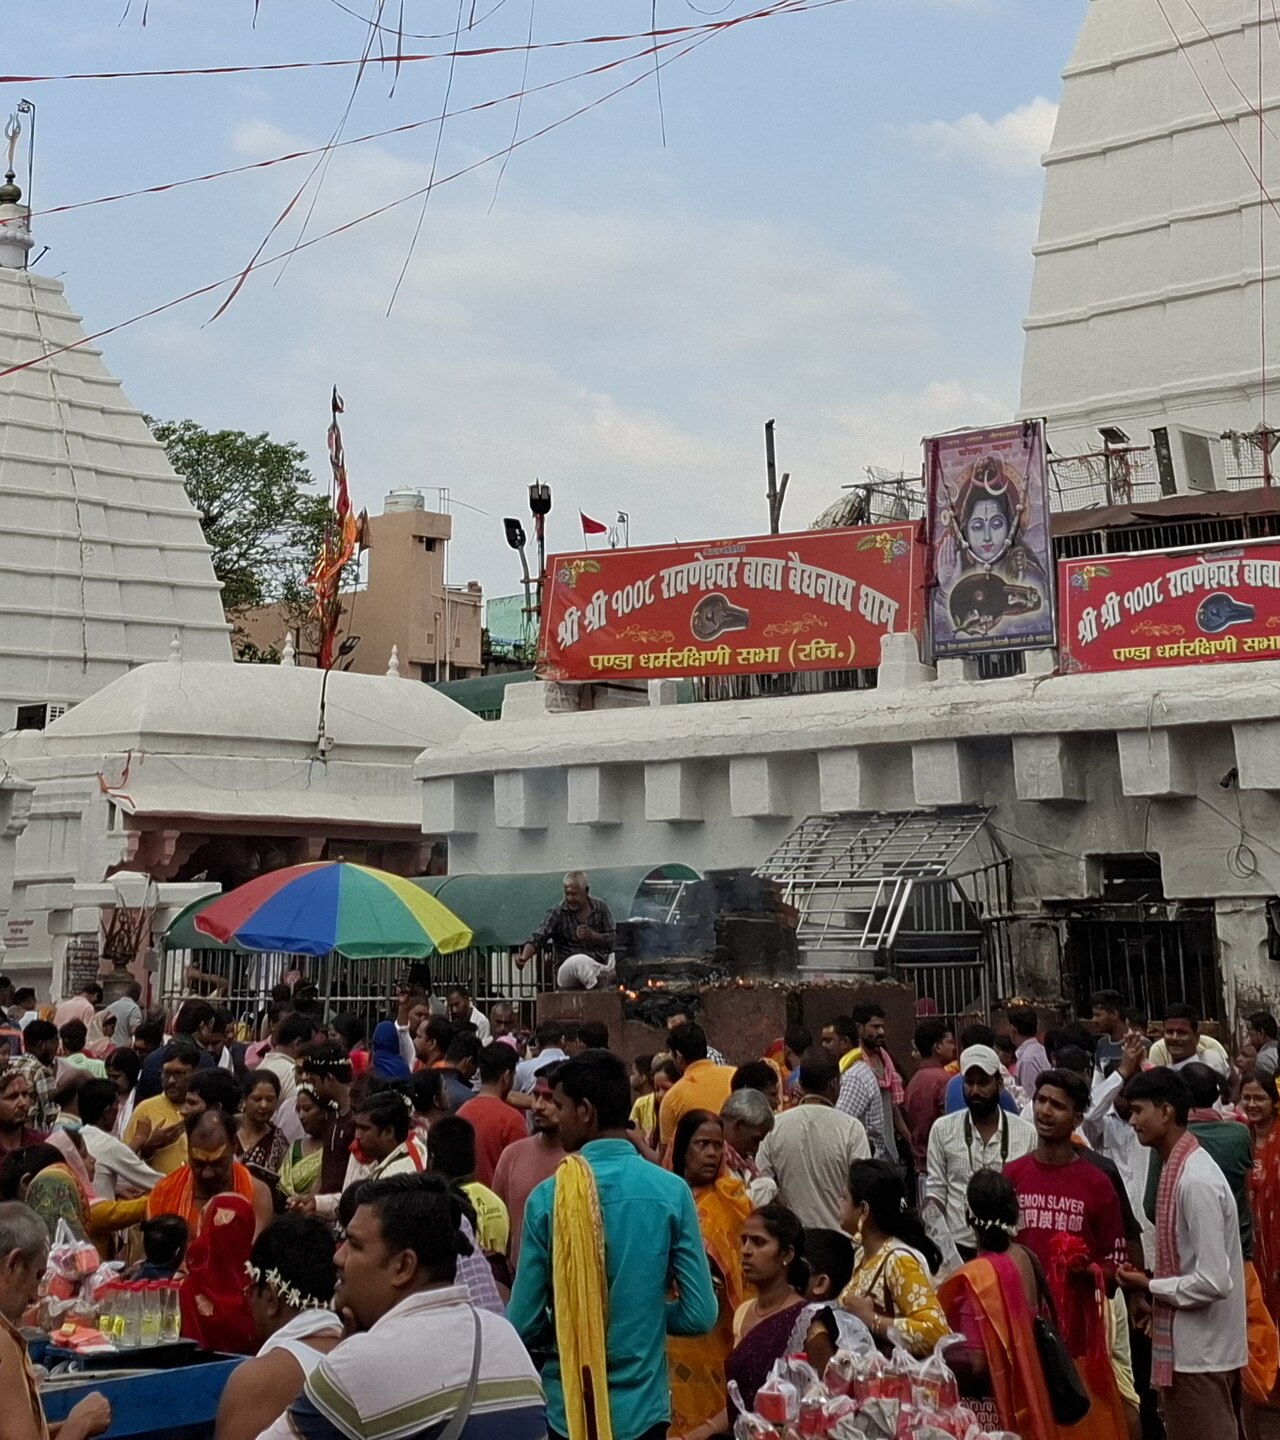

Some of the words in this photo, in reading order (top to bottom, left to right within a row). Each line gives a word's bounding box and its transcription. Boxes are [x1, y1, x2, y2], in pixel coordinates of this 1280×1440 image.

[557, 606, 580, 650] श्री
[584, 589, 609, 632] श्री
[612, 574, 655, 618] १००८
[660, 552, 740, 599] रावणेश्वर
[743, 556, 785, 591] बाबा
[1078, 605, 1098, 647] श्री
[1100, 590, 1121, 631] श्री
[1123, 576, 1164, 616] १००८
[1166, 556, 1241, 597] रावणेश्वर
[589, 653, 634, 672] पण्डा
[639, 644, 732, 669] धर्मरक्षिणी
[737, 645, 781, 665] सभा
[1112, 646, 1151, 662] पण्डा
[1156, 636, 1237, 660] धर्मरक्षिणी
[1019, 1193, 1045, 1208] EMON
[1048, 1195, 1084, 1214] SLAYER
